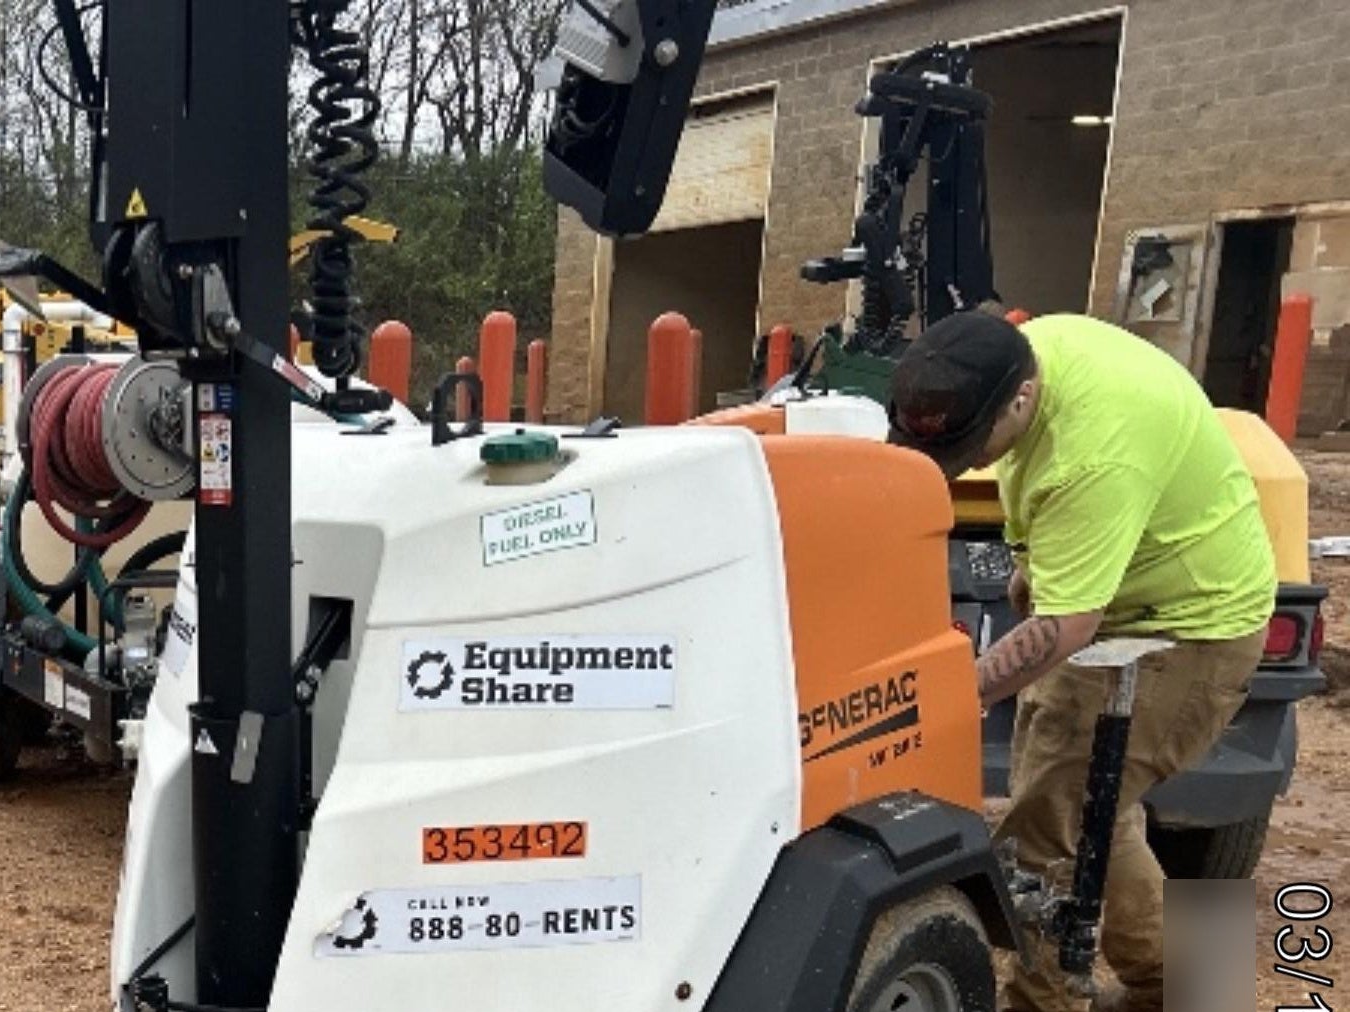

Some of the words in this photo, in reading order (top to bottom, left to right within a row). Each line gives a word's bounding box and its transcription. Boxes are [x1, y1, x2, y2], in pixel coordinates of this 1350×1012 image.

[503, 503, 568, 531] DIESEL
[489, 534, 535, 555] FUEL
[539, 521, 587, 544] ONLY
[462, 641, 673, 676] Equipment
[461, 677, 574, 704] Share
[426, 821, 585, 862] 353492
